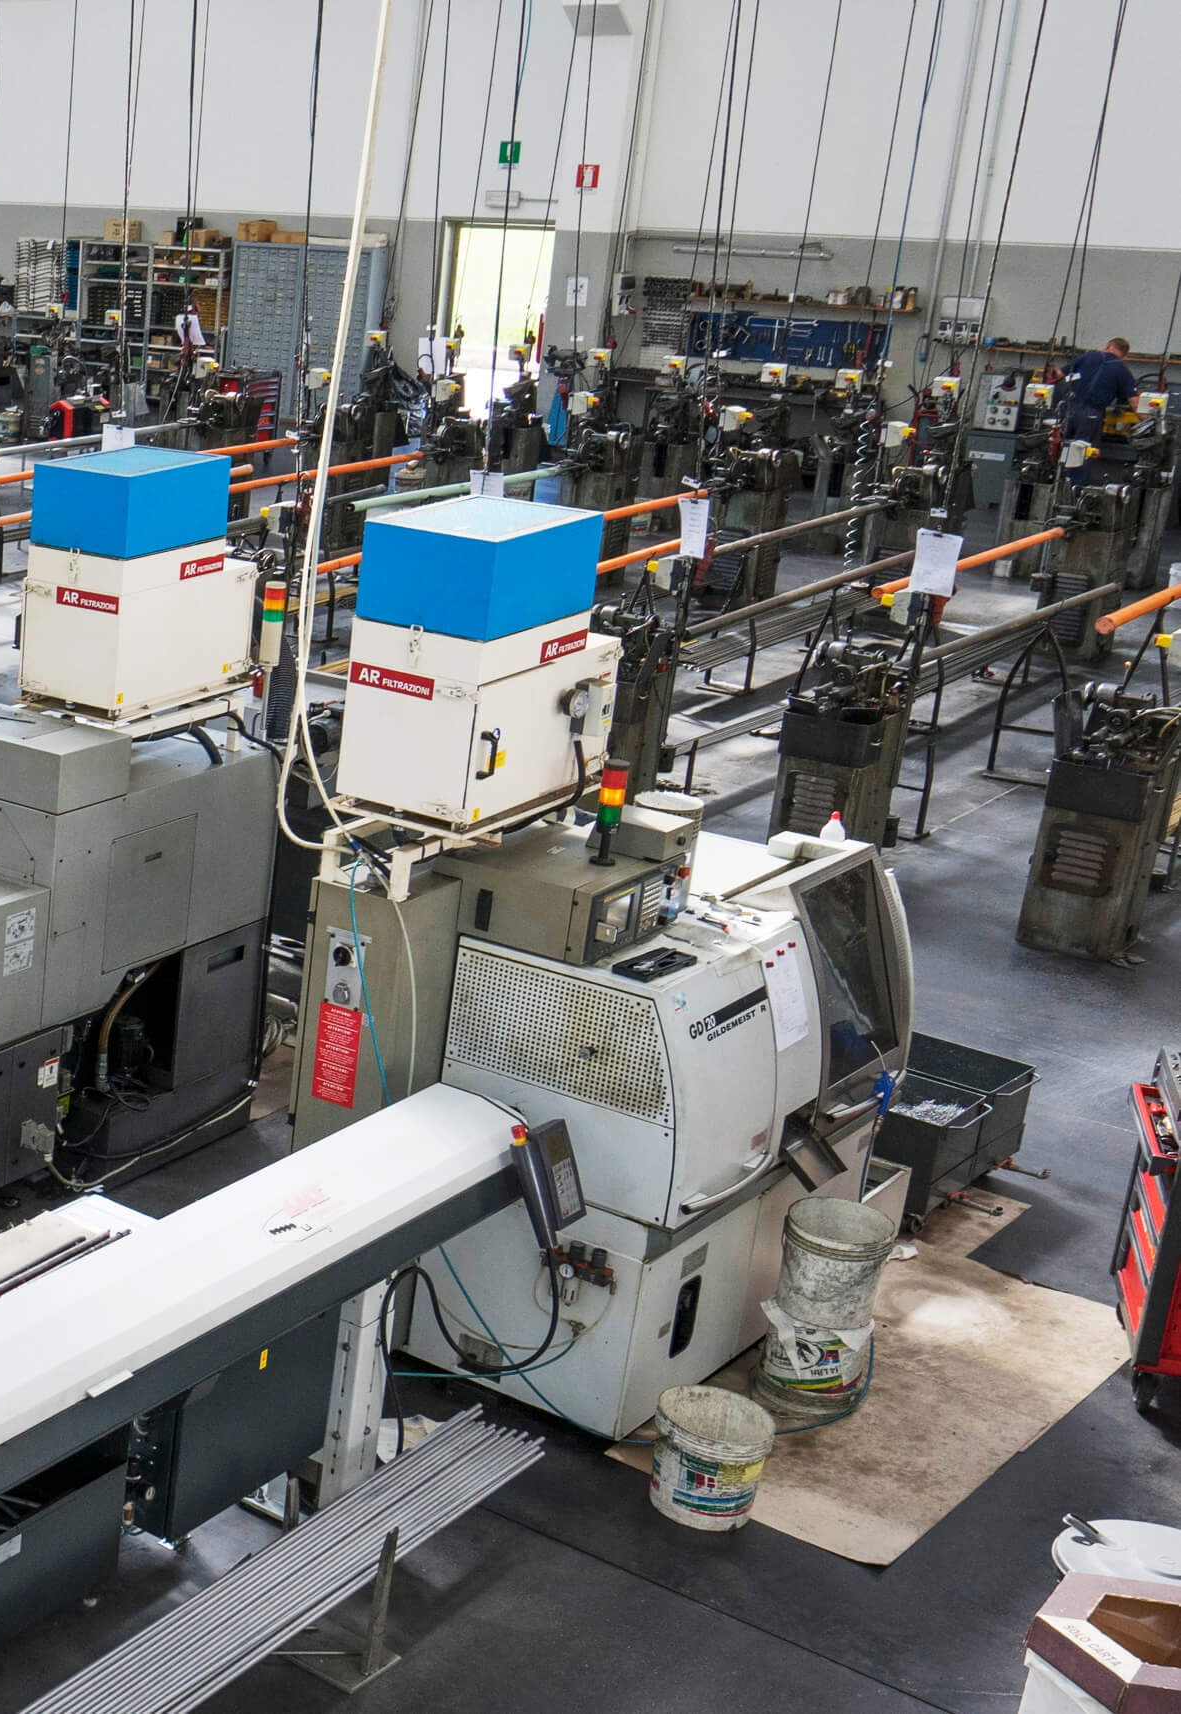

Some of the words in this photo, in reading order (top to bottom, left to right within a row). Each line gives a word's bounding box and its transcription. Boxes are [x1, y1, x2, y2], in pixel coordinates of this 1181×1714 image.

[183, 562, 197, 577] AR
[62, 591, 79, 604] AR
[545, 642, 558, 658] AR
[358, 667, 380, 685] AR
[382, 678, 430, 696] FILTRAZIONI
[689, 1020, 704, 1040] GD
[1087, 1643, 1123, 1667] CARTA
